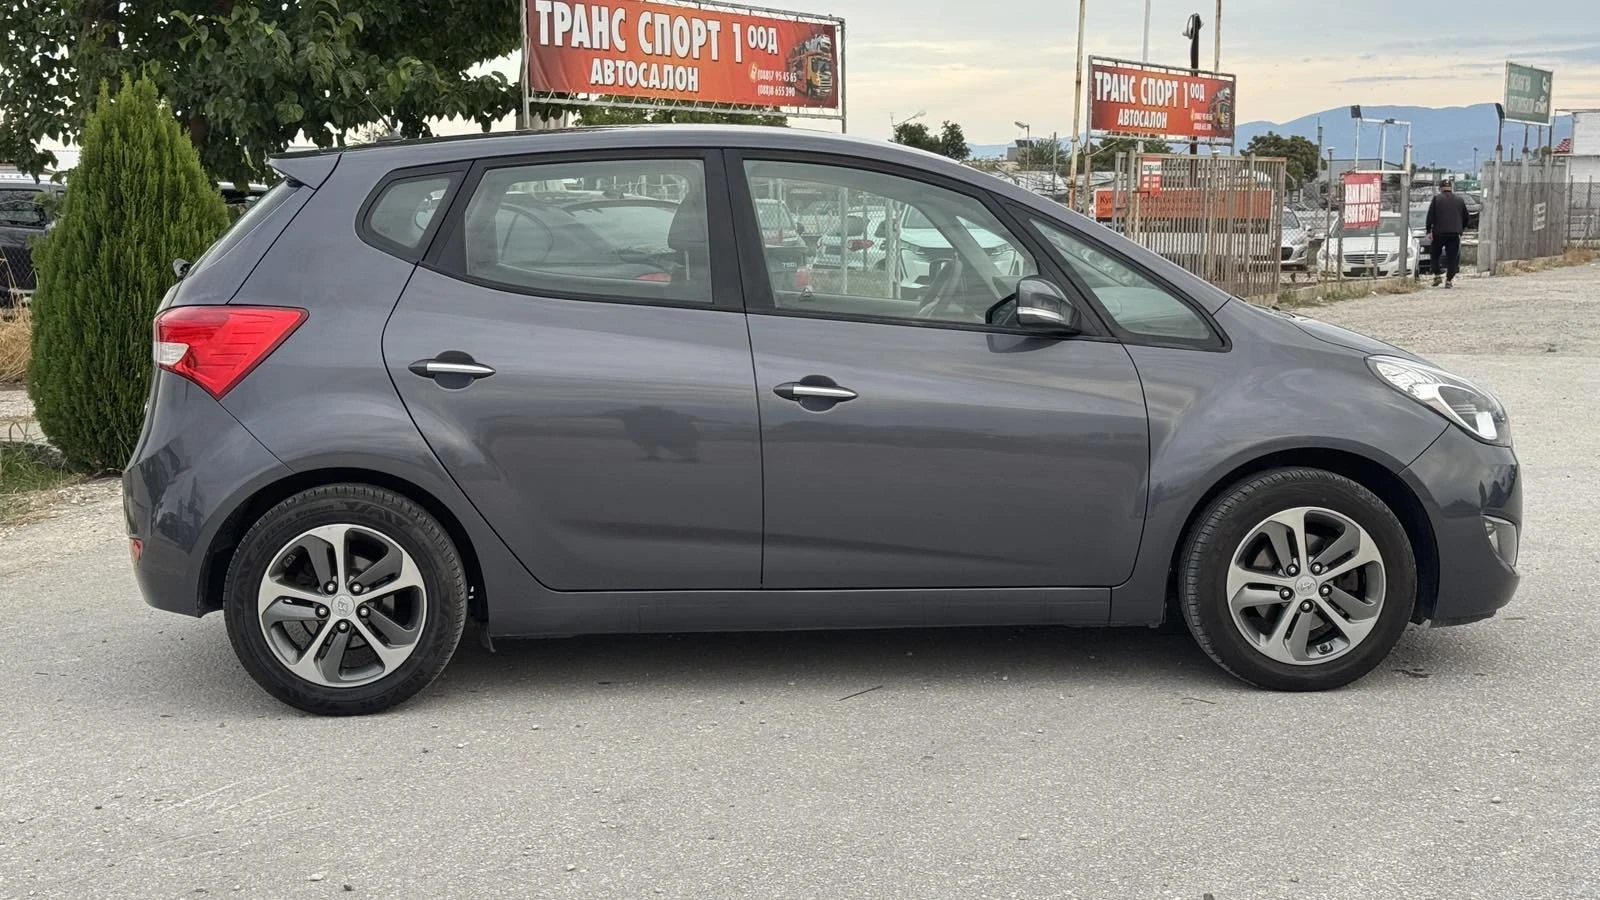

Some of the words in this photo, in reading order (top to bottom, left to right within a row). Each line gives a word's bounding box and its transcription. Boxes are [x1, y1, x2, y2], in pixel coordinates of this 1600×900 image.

[535, 0, 626, 52] ТРАНС
[638, 10, 721, 61] СПОРТ
[732, 23, 743, 63] 1
[747, 24, 779, 55] ООД
[590, 58, 699, 92] АВТОСАЛОН
[1094, 71, 1136, 104] ТРАНС
[1140, 77, 1179, 108] СПОРТ
[1183, 82, 1188, 109] 1
[1190, 83, 1205, 102] ООД
[1117, 108, 1168, 128] АВТОСАЛОН
